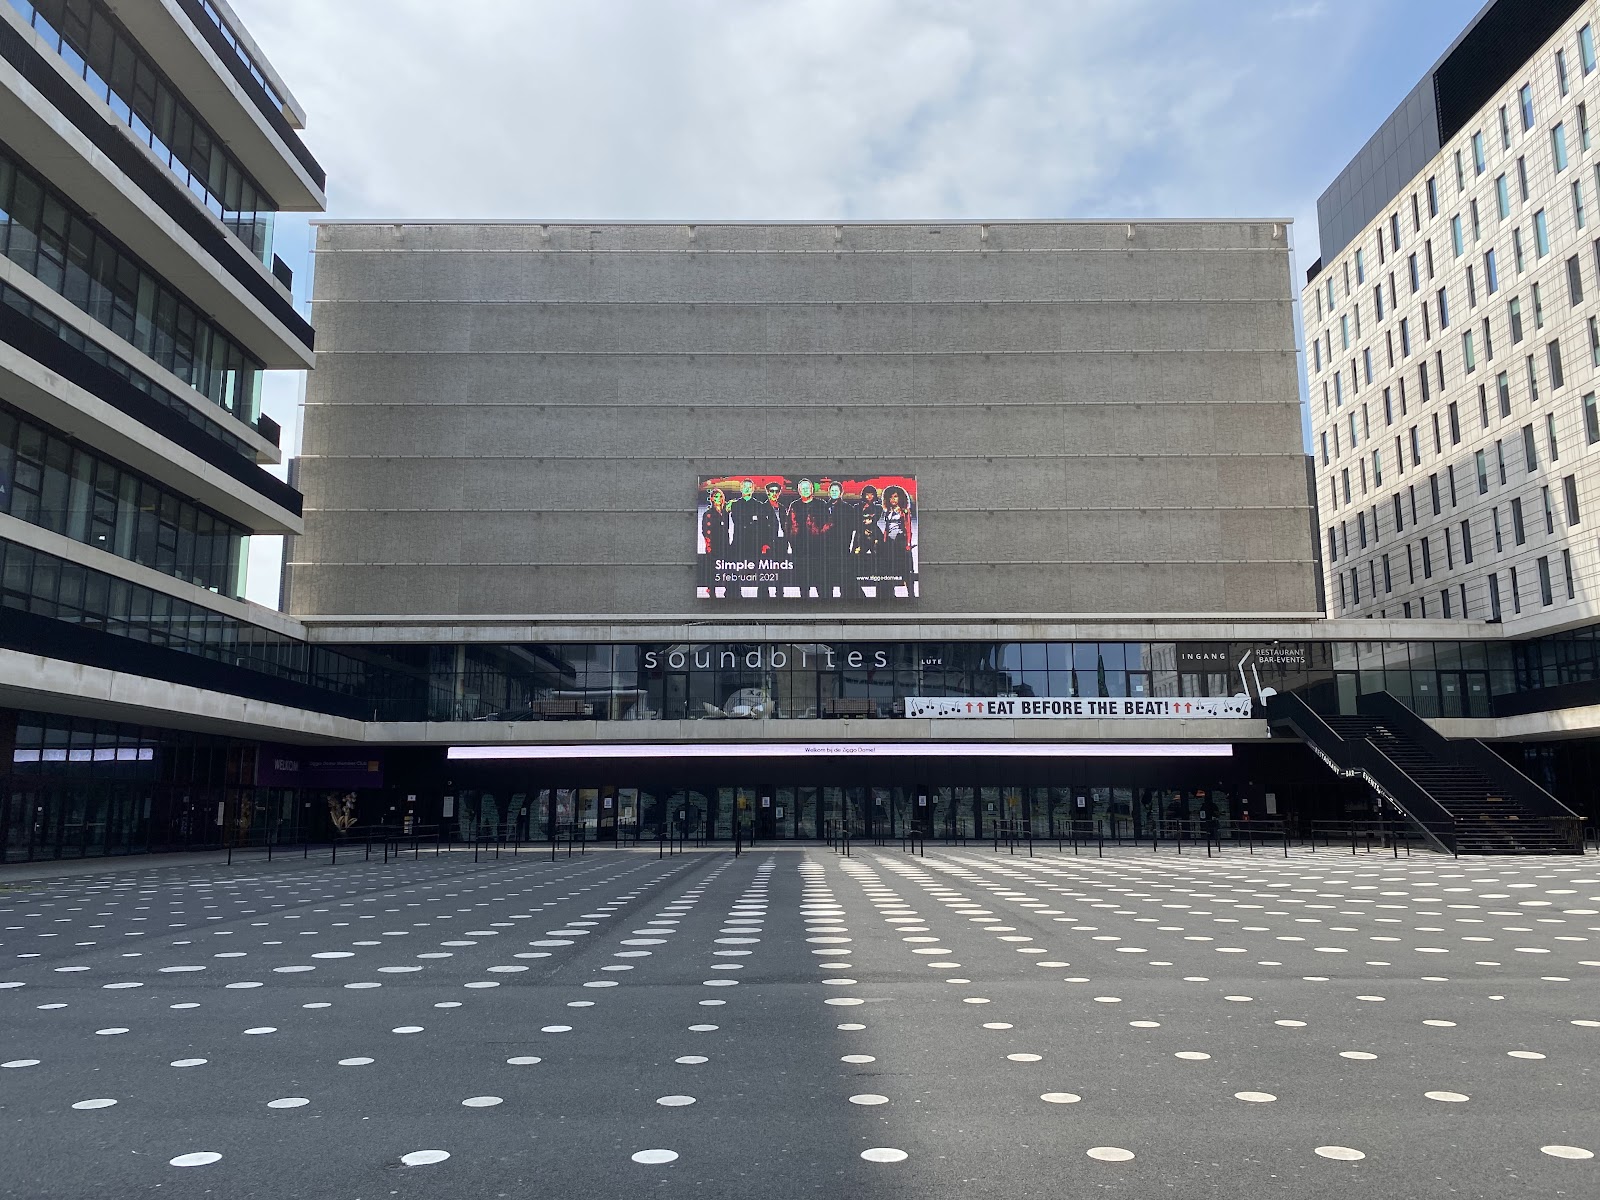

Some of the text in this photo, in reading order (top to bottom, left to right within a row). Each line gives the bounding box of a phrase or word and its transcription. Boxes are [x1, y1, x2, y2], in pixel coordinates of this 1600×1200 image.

[714, 559, 794, 571] Simple Minds
[715, 573, 721, 582] 5
[759, 573, 779, 582] 2021
[644, 645, 888, 669] soundbites
[1256, 648, 1305, 656] RESTAURANT
[1259, 656, 1306, 664] BAR-EVENTS
[987, 701, 1169, 715] EAT BEFORE THE BEAT!
